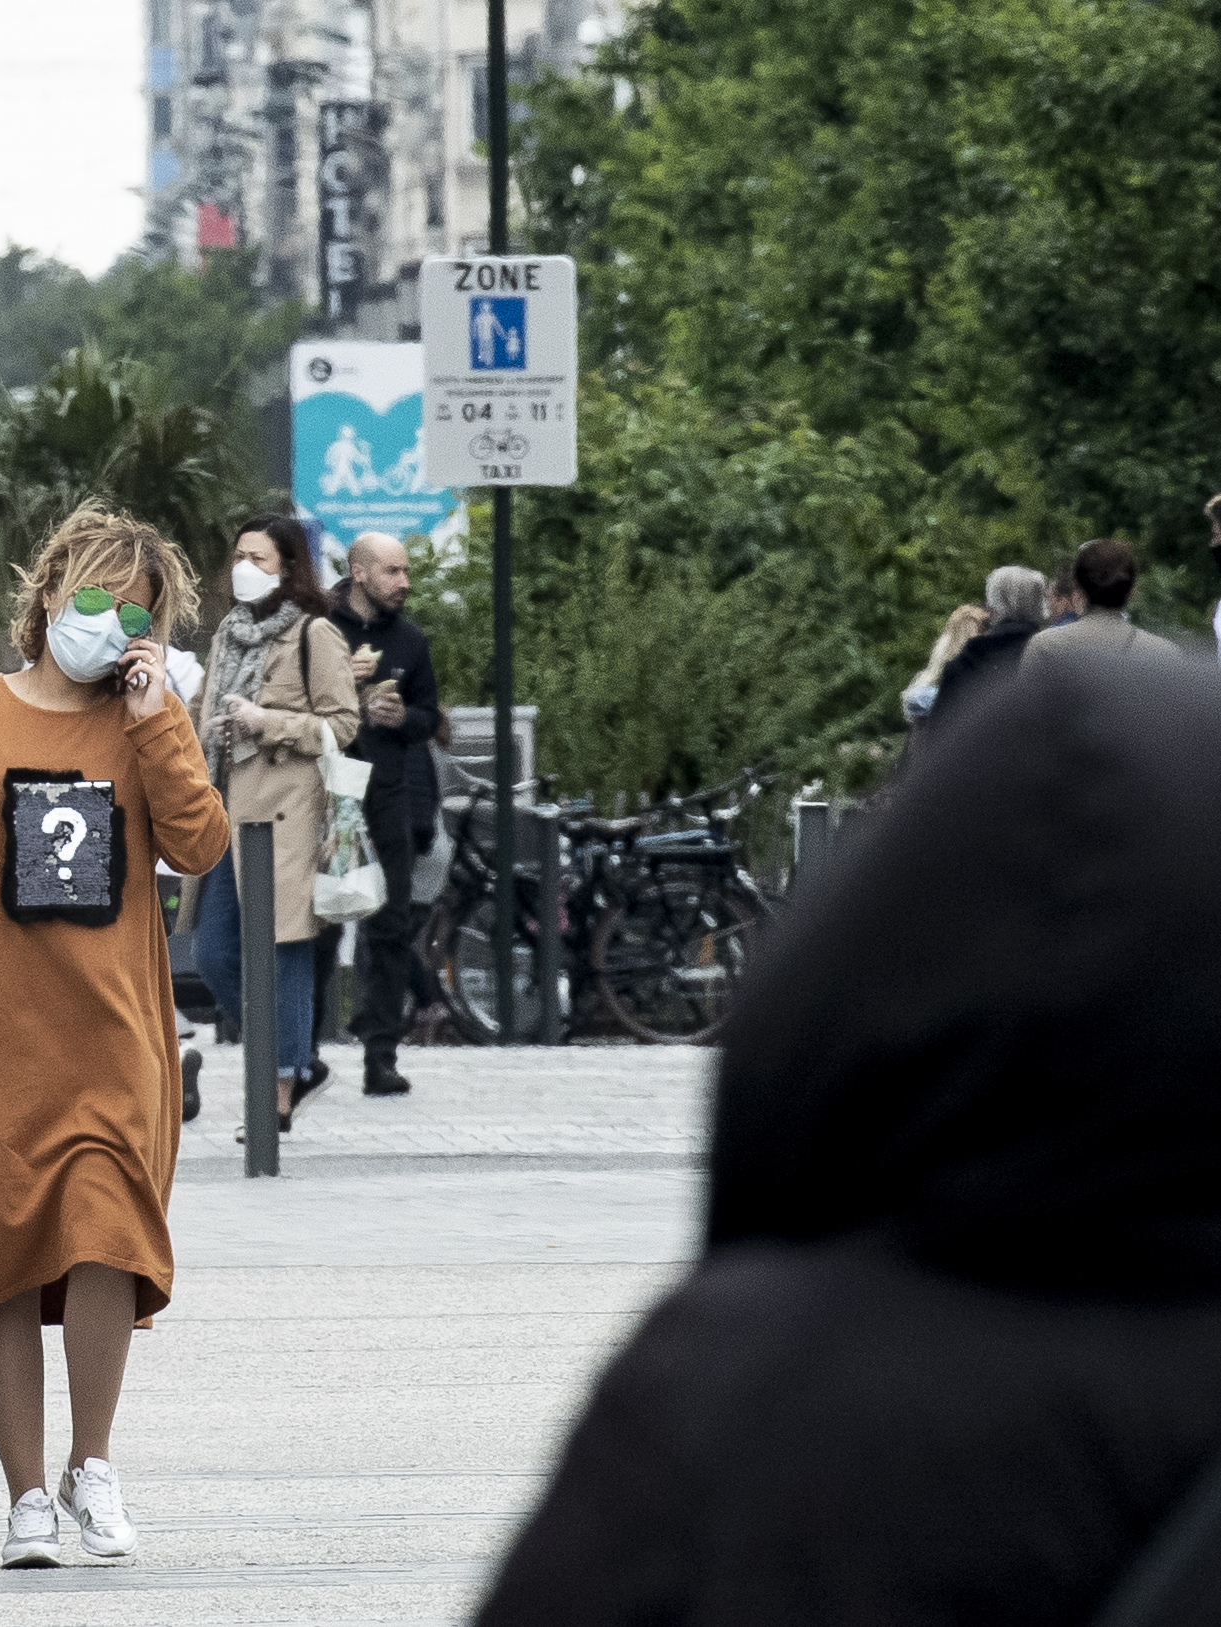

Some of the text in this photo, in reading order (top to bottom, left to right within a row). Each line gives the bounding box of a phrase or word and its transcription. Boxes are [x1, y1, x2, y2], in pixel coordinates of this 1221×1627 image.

[453, 262, 542, 291] ZONE
[480, 464, 522, 479] TAXI
[41, 807, 88, 881] ?
